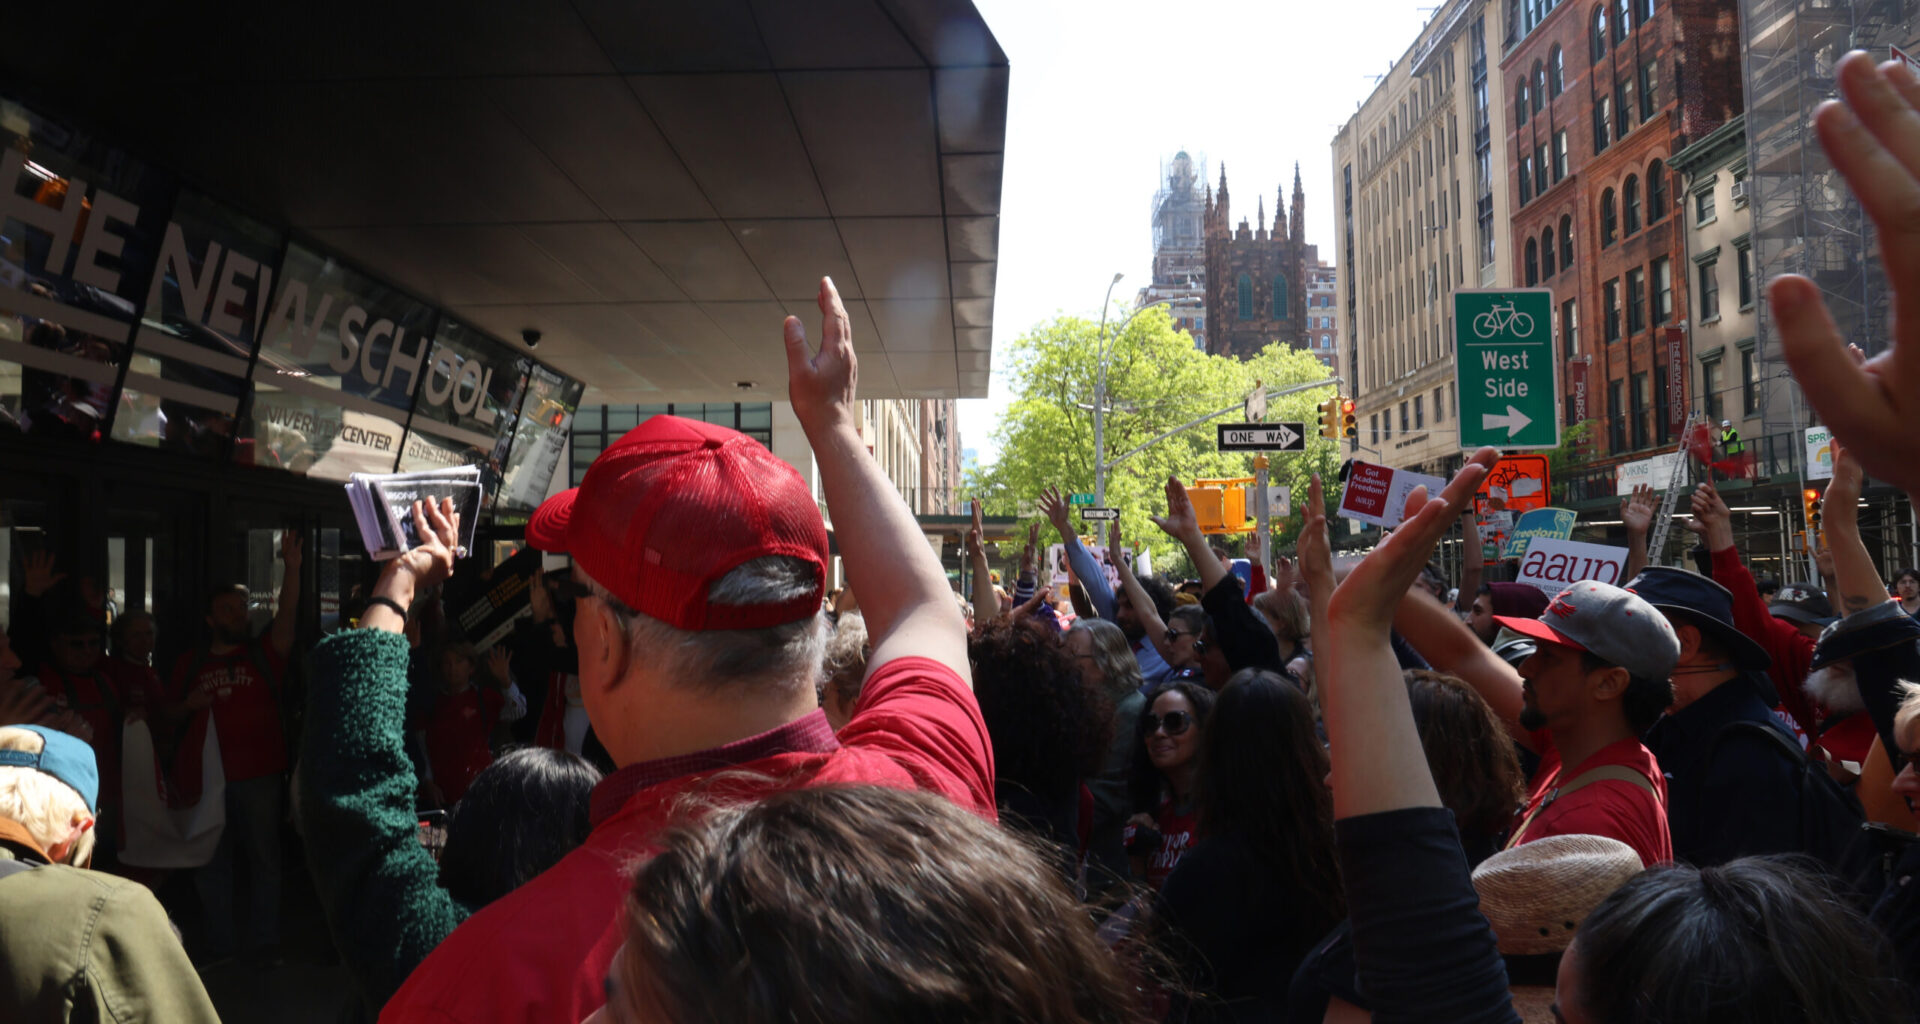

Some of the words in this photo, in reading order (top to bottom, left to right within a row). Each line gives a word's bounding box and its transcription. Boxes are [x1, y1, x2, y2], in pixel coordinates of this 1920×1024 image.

[0, 148, 140, 294] HE
[146, 221, 333, 358] NEW
[328, 304, 497, 425] SCHOOL
[1673, 340, 1681, 358] THE
[1482, 350, 1529, 370] West
[1673, 359, 1682, 386] NEW
[1485, 378, 1528, 397] Side
[1575, 382, 1587, 444] PARSOS
[1673, 385, 1684, 424] SCHOOL
[341, 425, 392, 451] CENTER
[1230, 432, 1254, 443] ONE
[1266, 431, 1291, 443] WAY
[1807, 432, 1830, 444] SPR
[1365, 467, 1379, 476] Got
[1626, 464, 1648, 476] VIKING
[1350, 481, 1387, 496] Freedom?
[1353, 473, 1388, 488] Academic
[1355, 495, 1376, 509] aaup
